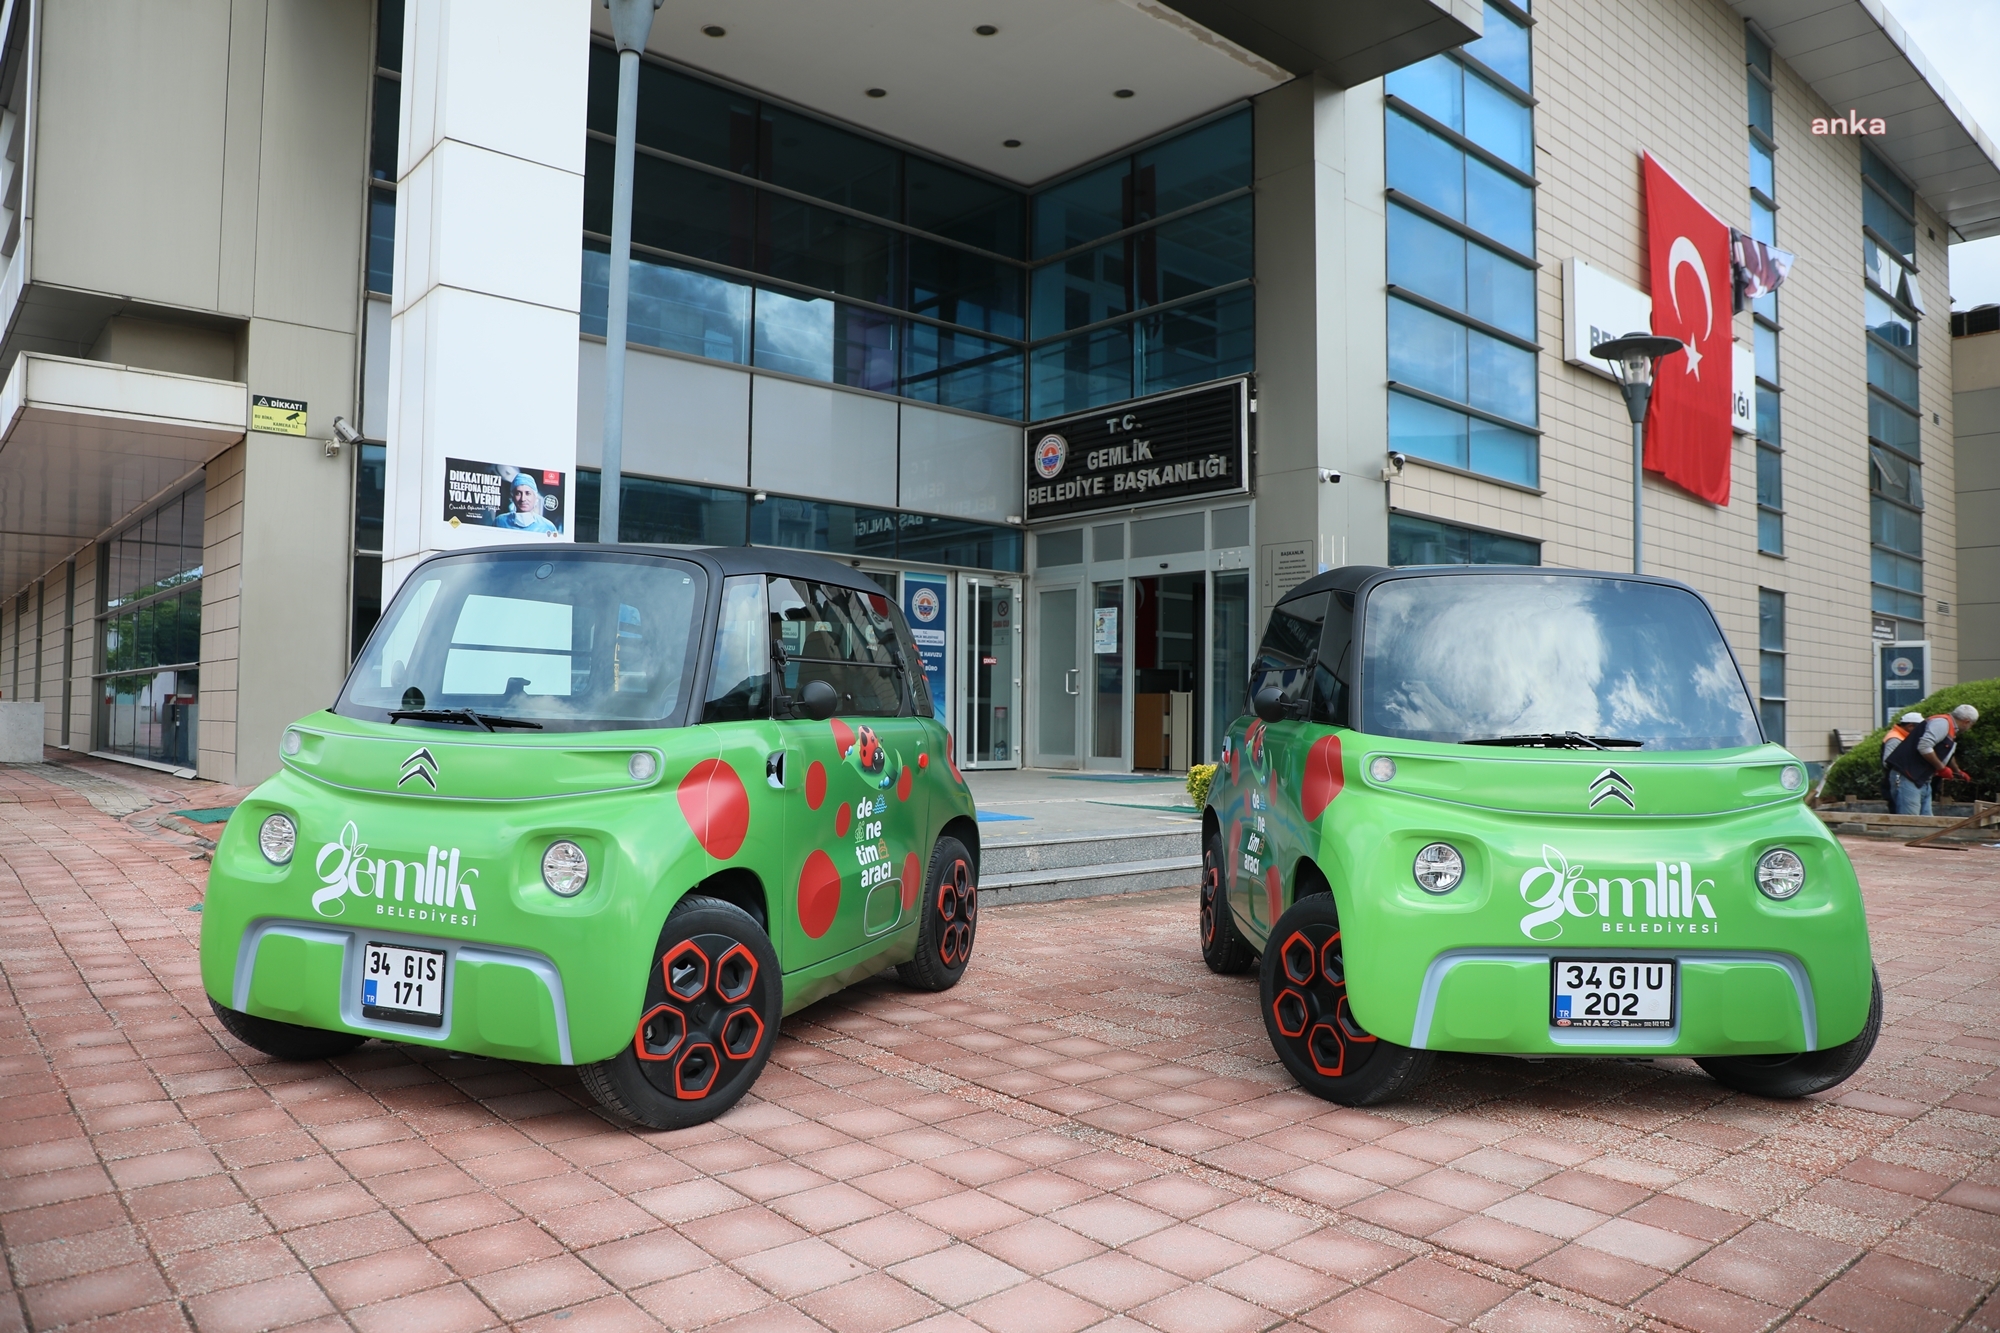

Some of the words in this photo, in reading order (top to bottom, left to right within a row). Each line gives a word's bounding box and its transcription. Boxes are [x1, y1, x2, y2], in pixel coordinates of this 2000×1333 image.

[271, 400, 303, 410] DİKKAT!
[1087, 439, 1153, 470] GEMLİK
[450, 481, 482, 493] TELEFONA
[1028, 475, 1105, 505] BELEDİYE
[1114, 454, 1227, 493] BAŞKANLIĞI
[449, 490, 472, 504] YOLA
[856, 796, 873, 819] de
[1252, 788, 1260, 809] de
[866, 820, 882, 840] ne
[1257, 815, 1265, 833] ne
[856, 844, 879, 866] tim
[312, 838, 479, 917] gemlik
[861, 861, 891, 888] aracı
[1519, 859, 1717, 941] gemlik
[376, 904, 477, 926] BELEDİYESİ
[1602, 921, 1718, 933] BELEDİYESİ
[370, 951, 390, 975] 34
[404, 955, 437, 981] GIS
[366, 995, 375, 1003] TR
[394, 981, 423, 1007] 171
[1585, 992, 1639, 1016] 202
